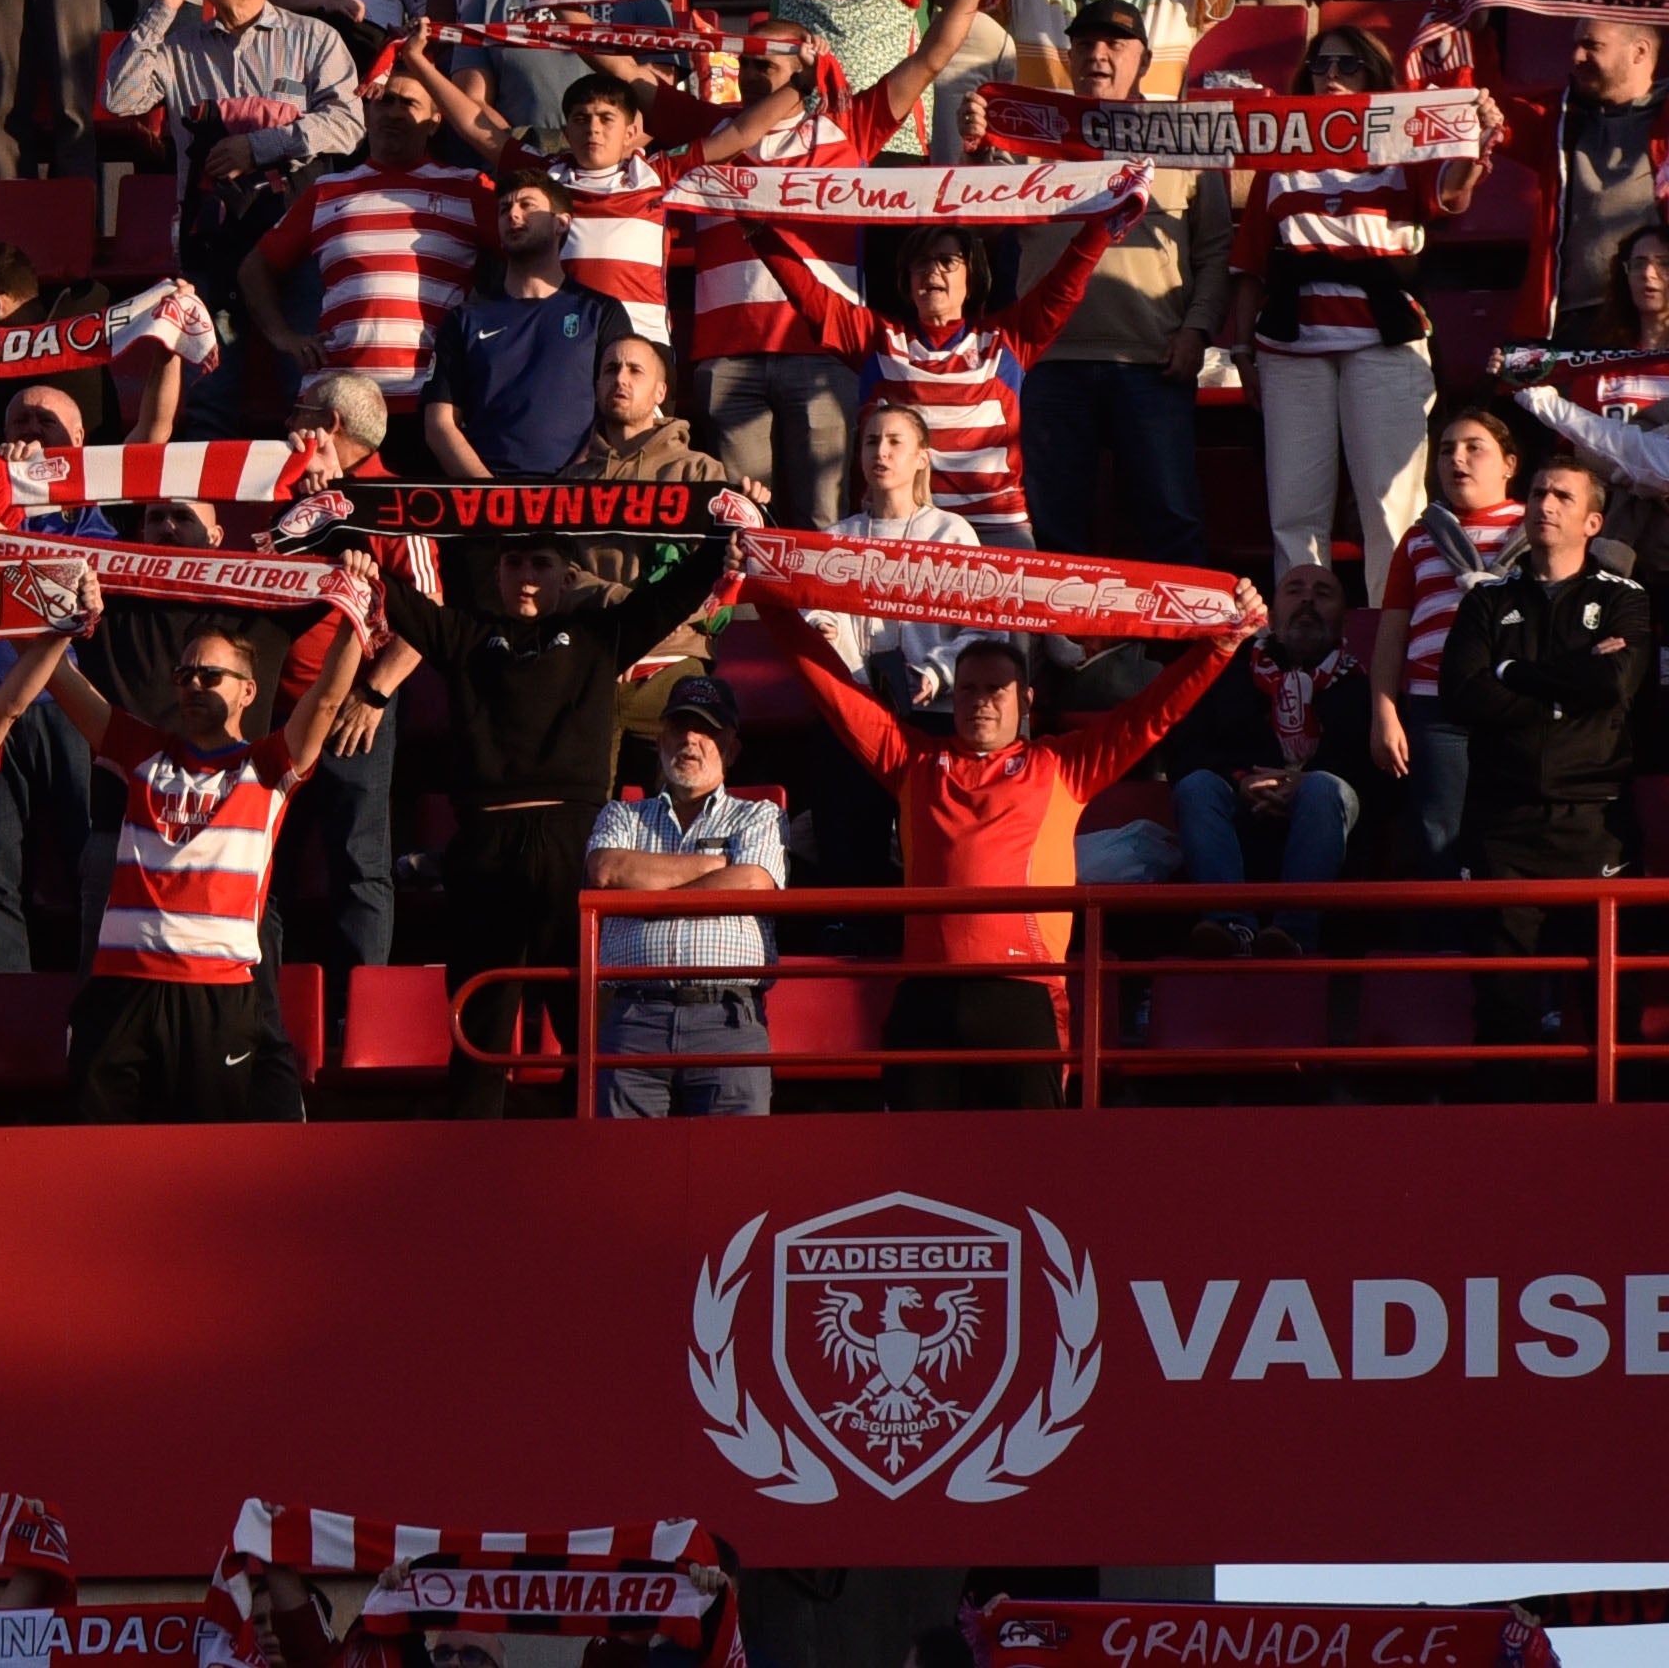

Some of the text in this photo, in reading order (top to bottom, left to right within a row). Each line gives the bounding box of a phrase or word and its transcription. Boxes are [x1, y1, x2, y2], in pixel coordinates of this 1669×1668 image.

[780, 162, 1084, 214] Eterna Lucha
[107, 553, 173, 579] CLUB
[180, 560, 213, 582] DE
[915, 542, 941, 554] paz
[1014, 555, 1045, 568] para
[815, 547, 1129, 620] GRANADA C.F.
[976, 612, 994, 625] LA
[799, 1245, 994, 1273] VADISEGUR
[849, 1415, 941, 1438] SEGURIDAD
[1101, 1618, 1459, 1668] GRANADA C.F.
